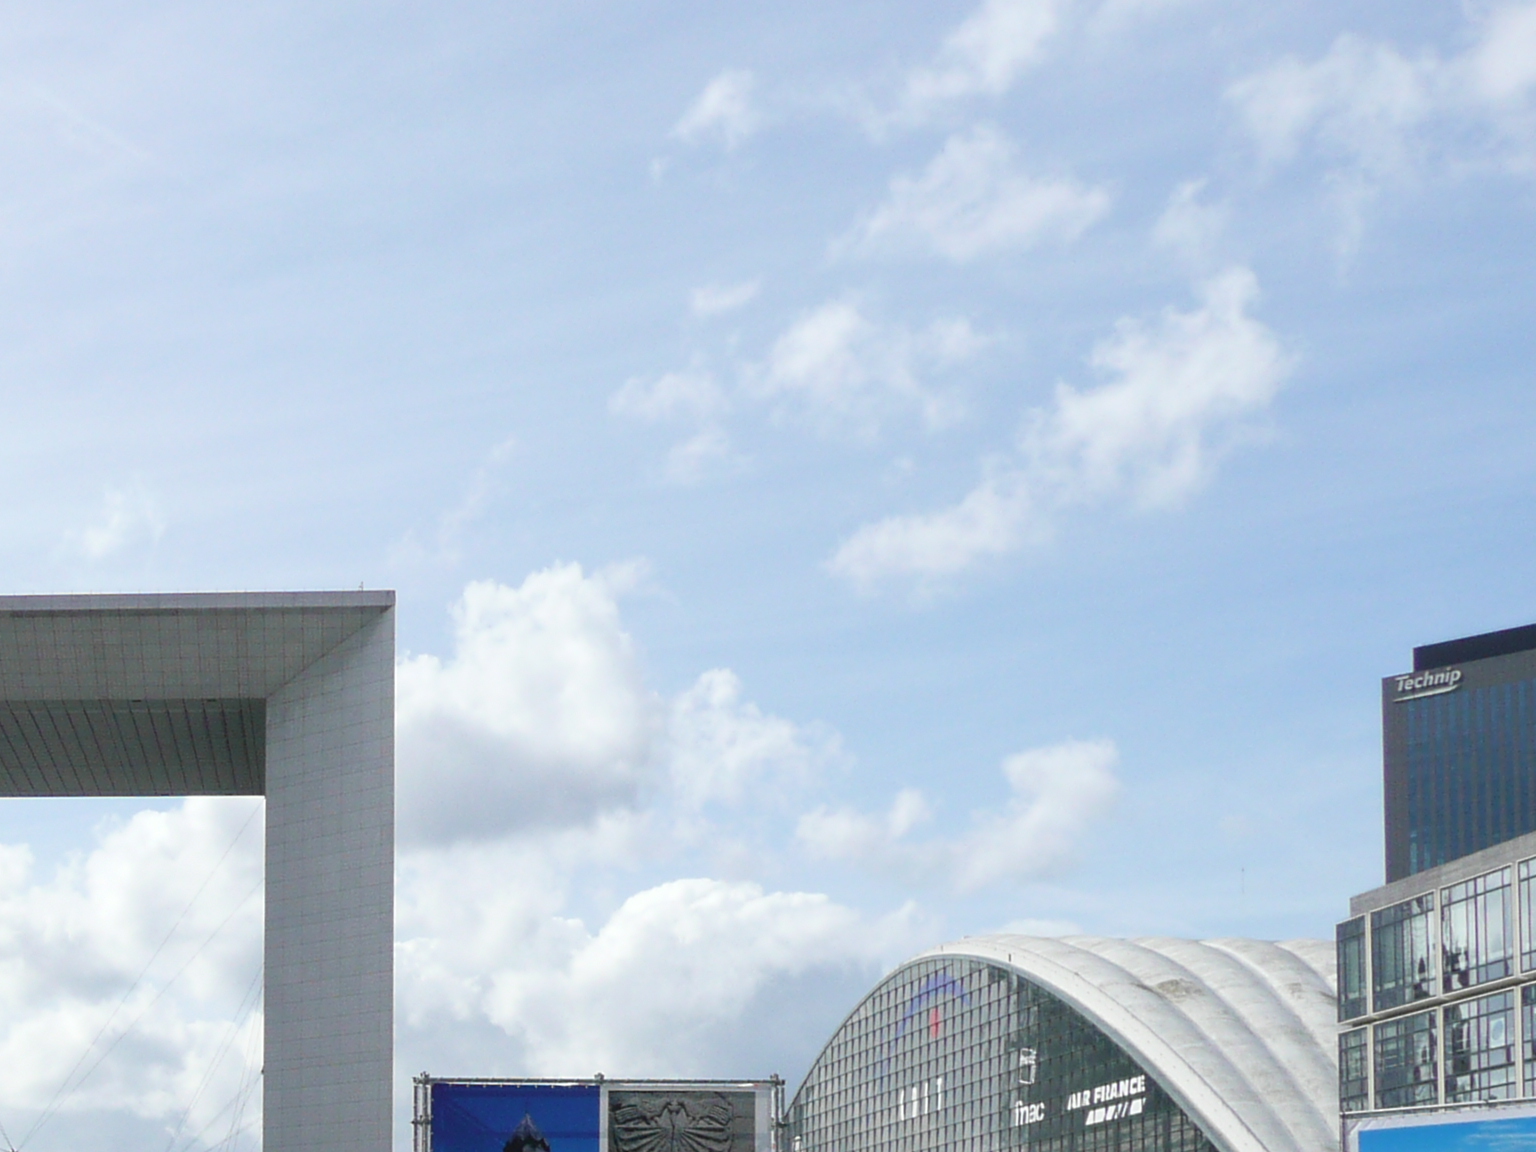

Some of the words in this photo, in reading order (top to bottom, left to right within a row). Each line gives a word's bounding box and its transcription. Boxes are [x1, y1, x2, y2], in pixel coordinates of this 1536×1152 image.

[1395, 666, 1462, 692] Technip
[1066, 1089, 1091, 1111] AIR
[1093, 1075, 1146, 1105] FRANCE
[1015, 1100, 1045, 1126] fnac
